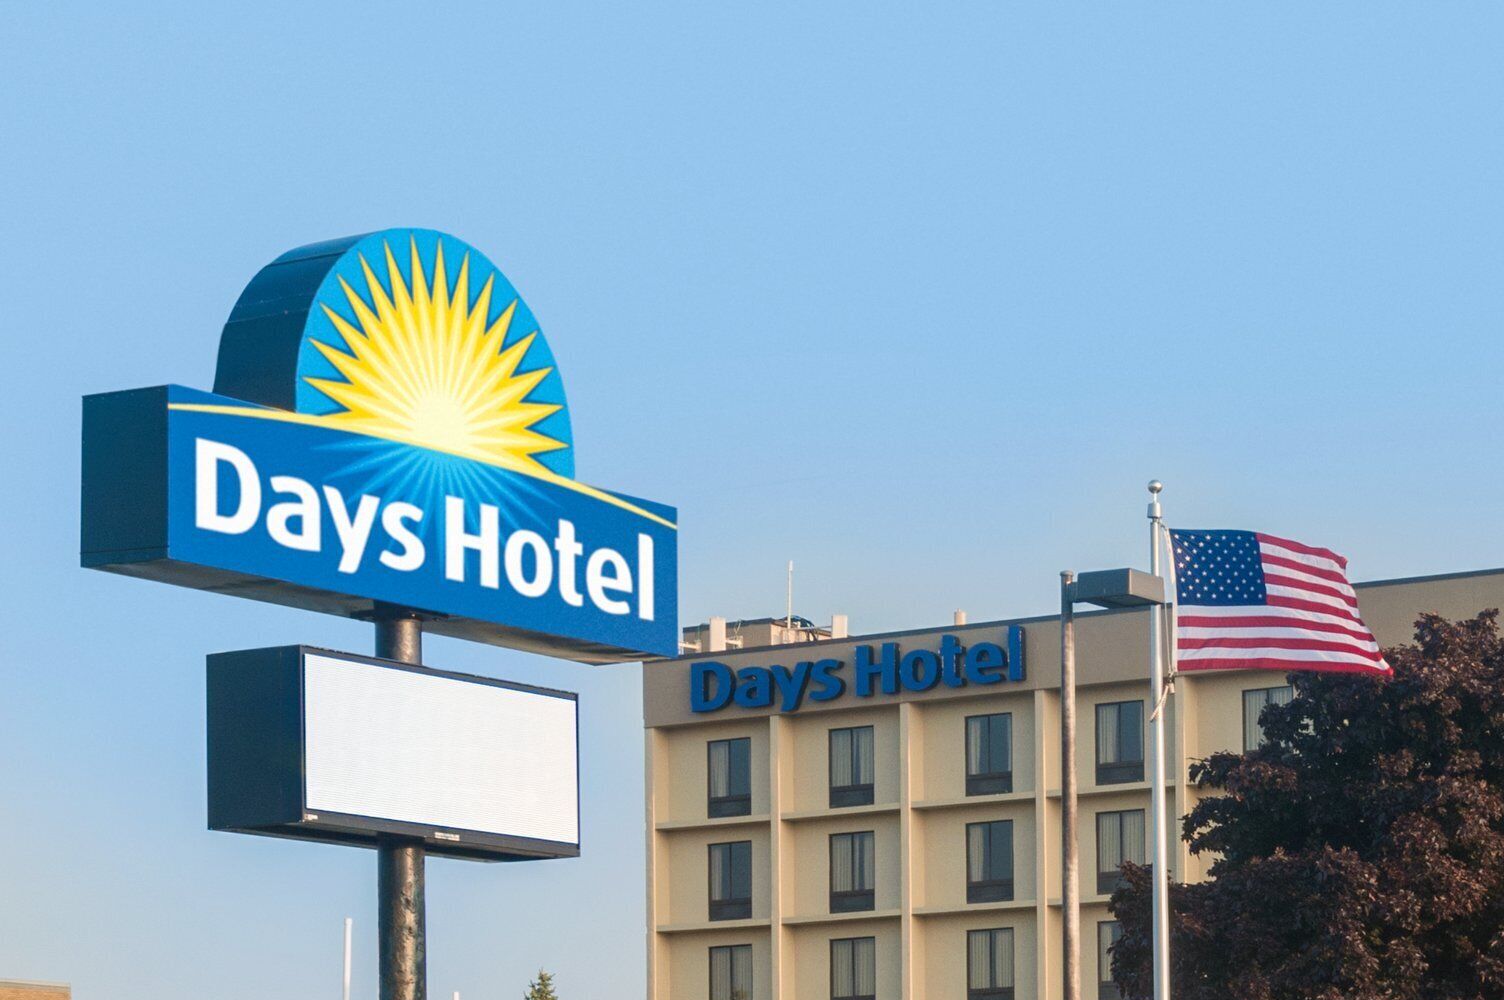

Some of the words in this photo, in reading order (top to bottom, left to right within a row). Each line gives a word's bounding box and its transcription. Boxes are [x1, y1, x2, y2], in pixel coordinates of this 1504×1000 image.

[195, 437, 426, 575] Days
[444, 494, 655, 622] Hotel
[689, 659, 846, 714] Days
[854, 623, 1027, 697] Hotel
